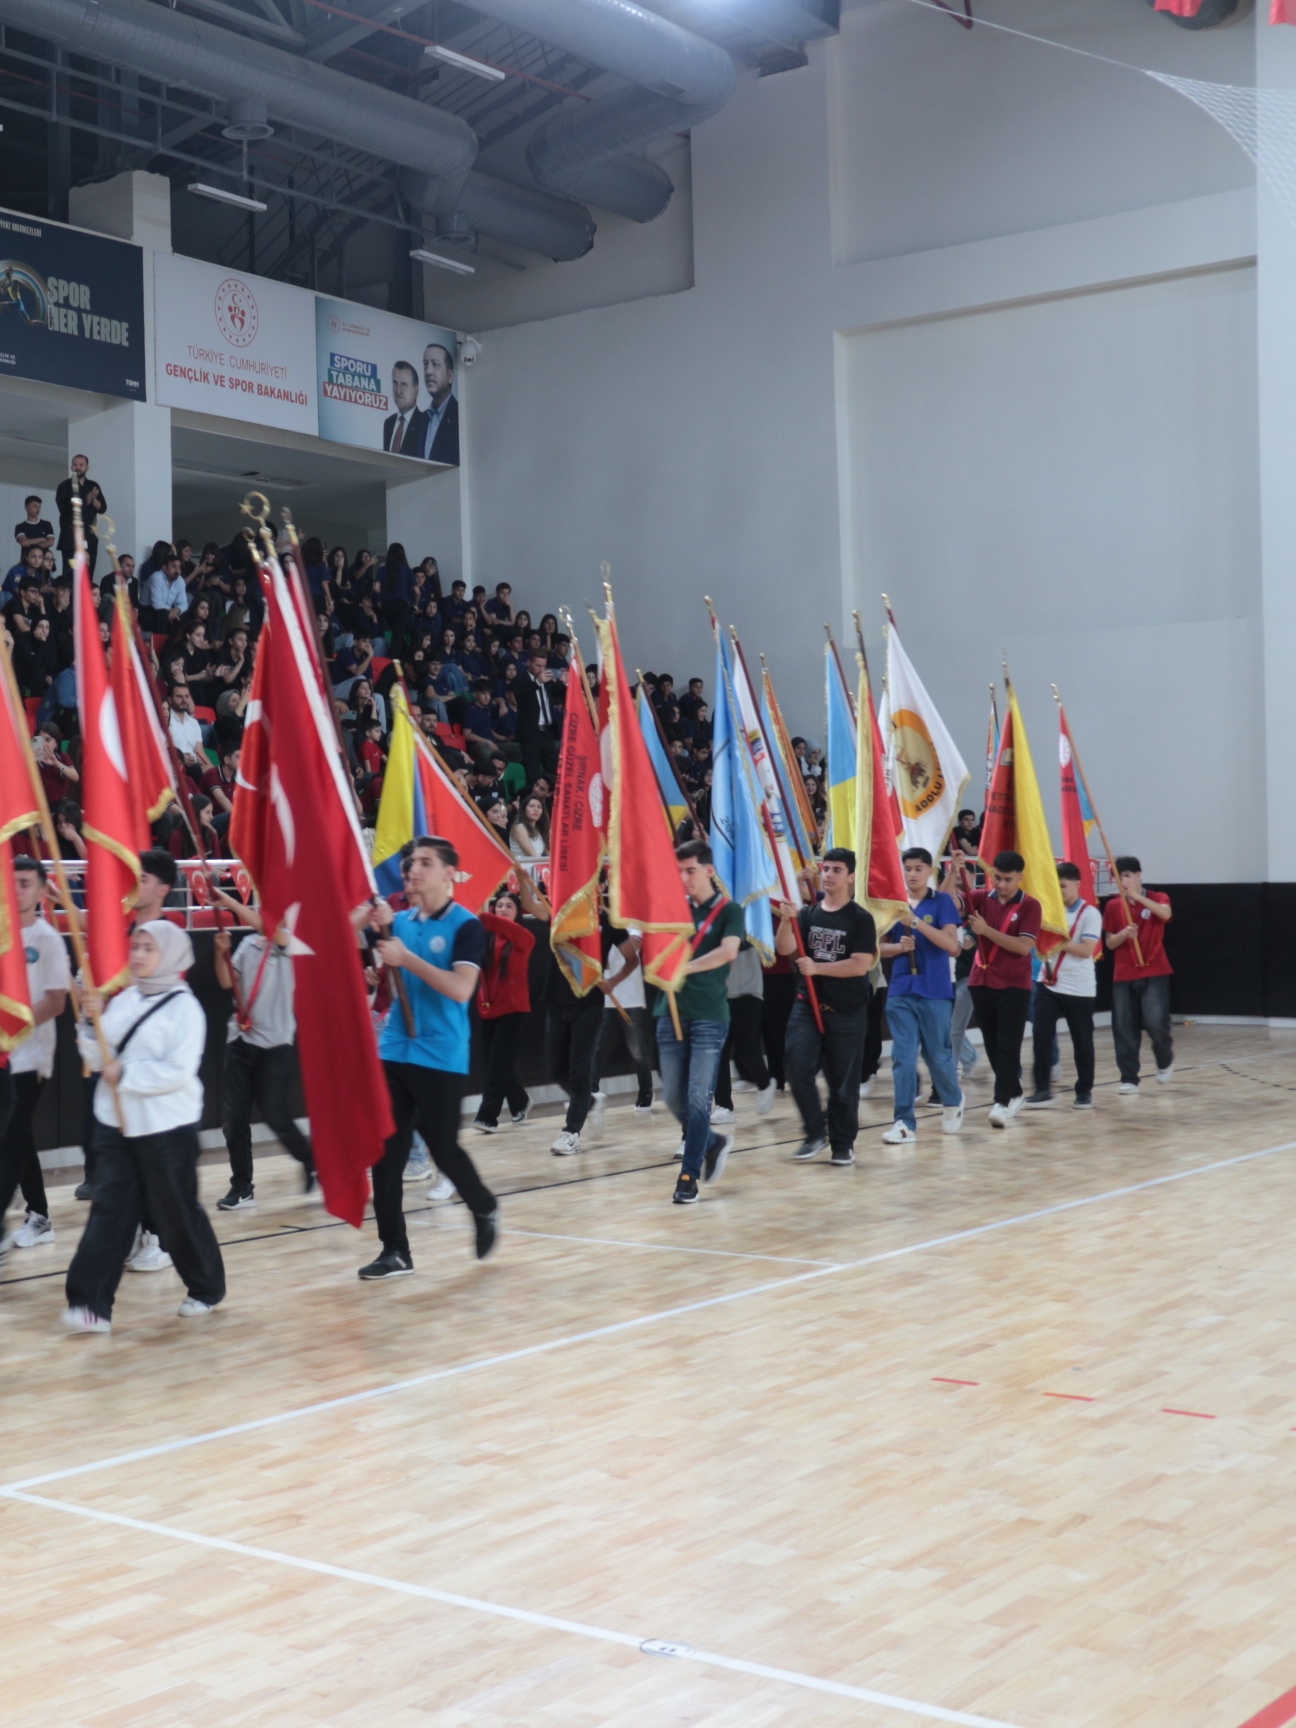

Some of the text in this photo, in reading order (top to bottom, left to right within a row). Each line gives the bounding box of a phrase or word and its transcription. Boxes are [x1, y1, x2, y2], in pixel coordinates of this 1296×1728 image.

[47, 276, 91, 311] SPOR
[82, 312, 129, 347] YERDE
[187, 344, 287, 380] TÜRKİYE CUMHURİYETİ
[333, 355, 372, 376] SPORU
[165, 362, 308, 406] GENÇLİK VE SPOR BAKANLIĞI
[324, 383, 387, 409] YAYIYORUZ
[330, 370, 377, 391] TABANA
[567, 712, 579, 743] CİZRE
[564, 745, 576, 779] GÜZEL
[574, 755, 587, 793] ŞIRNAK
[561, 781, 573, 837] SANATLAR
[572, 802, 585, 831] CİZRE
[808, 930, 846, 954] CFL
